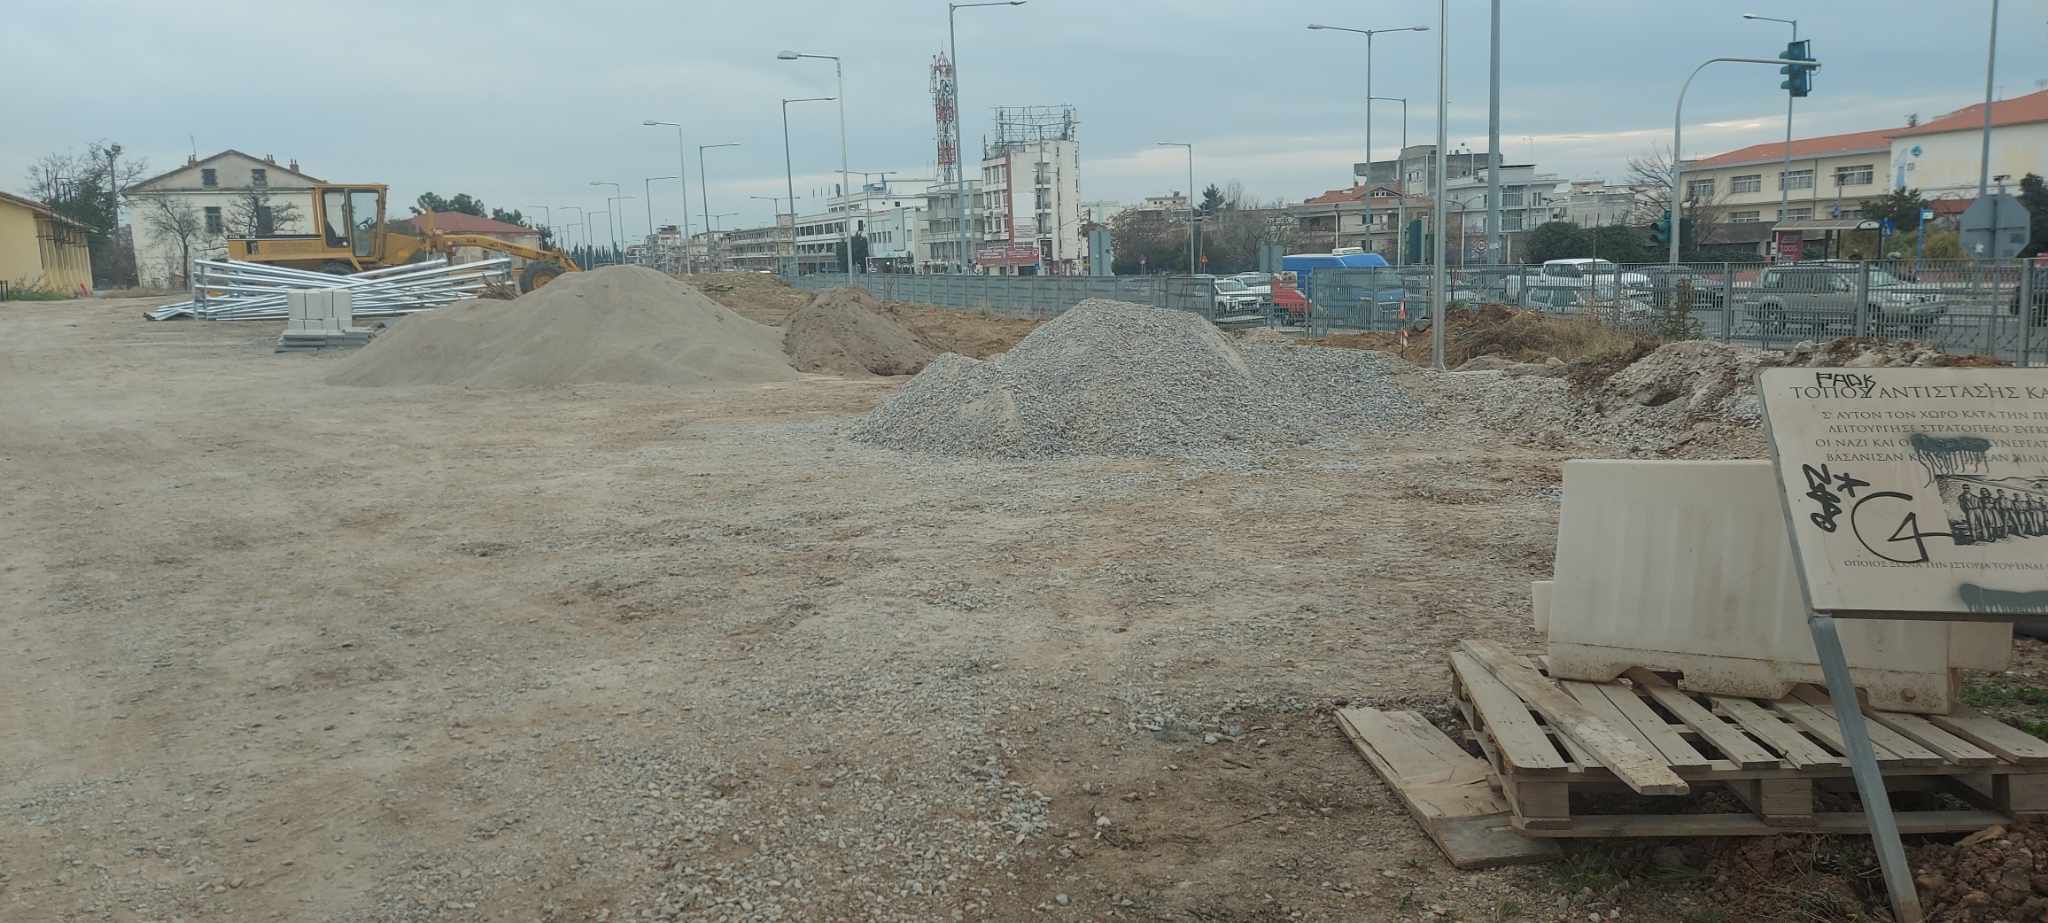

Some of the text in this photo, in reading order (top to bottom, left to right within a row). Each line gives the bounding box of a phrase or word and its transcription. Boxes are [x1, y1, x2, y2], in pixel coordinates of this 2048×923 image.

[1789, 386, 1873, 399] ΤΟΠΟΣ
[1879, 385, 2021, 399] ΑΝΤΙΣΤΑΣΗΣ
[1837, 411, 1881, 420] ΑΥΤΟΝ
[1884, 411, 1916, 420] ΤΟΝ
[1919, 410, 1958, 419] ΧΩΡΟ
[1961, 410, 1997, 418] ΚΑΤΑ
[1999, 411, 2029, 420] ΤΗΝ
[1828, 424, 1917, 433] ΛΕΙΤΟΥΡΓΗΣΕ
[1920, 424, 2010, 434] ΣΤΡΑΤΟΠΕΔΟ
[1815, 439, 1832, 448] ΟΙ
[1834, 439, 1868, 448] ΝΑΖΙ
[1872, 439, 1896, 448] ΚΑΙ
[1825, 453, 1904, 462] ΒΑΣΑΝΙΣΑΝ
